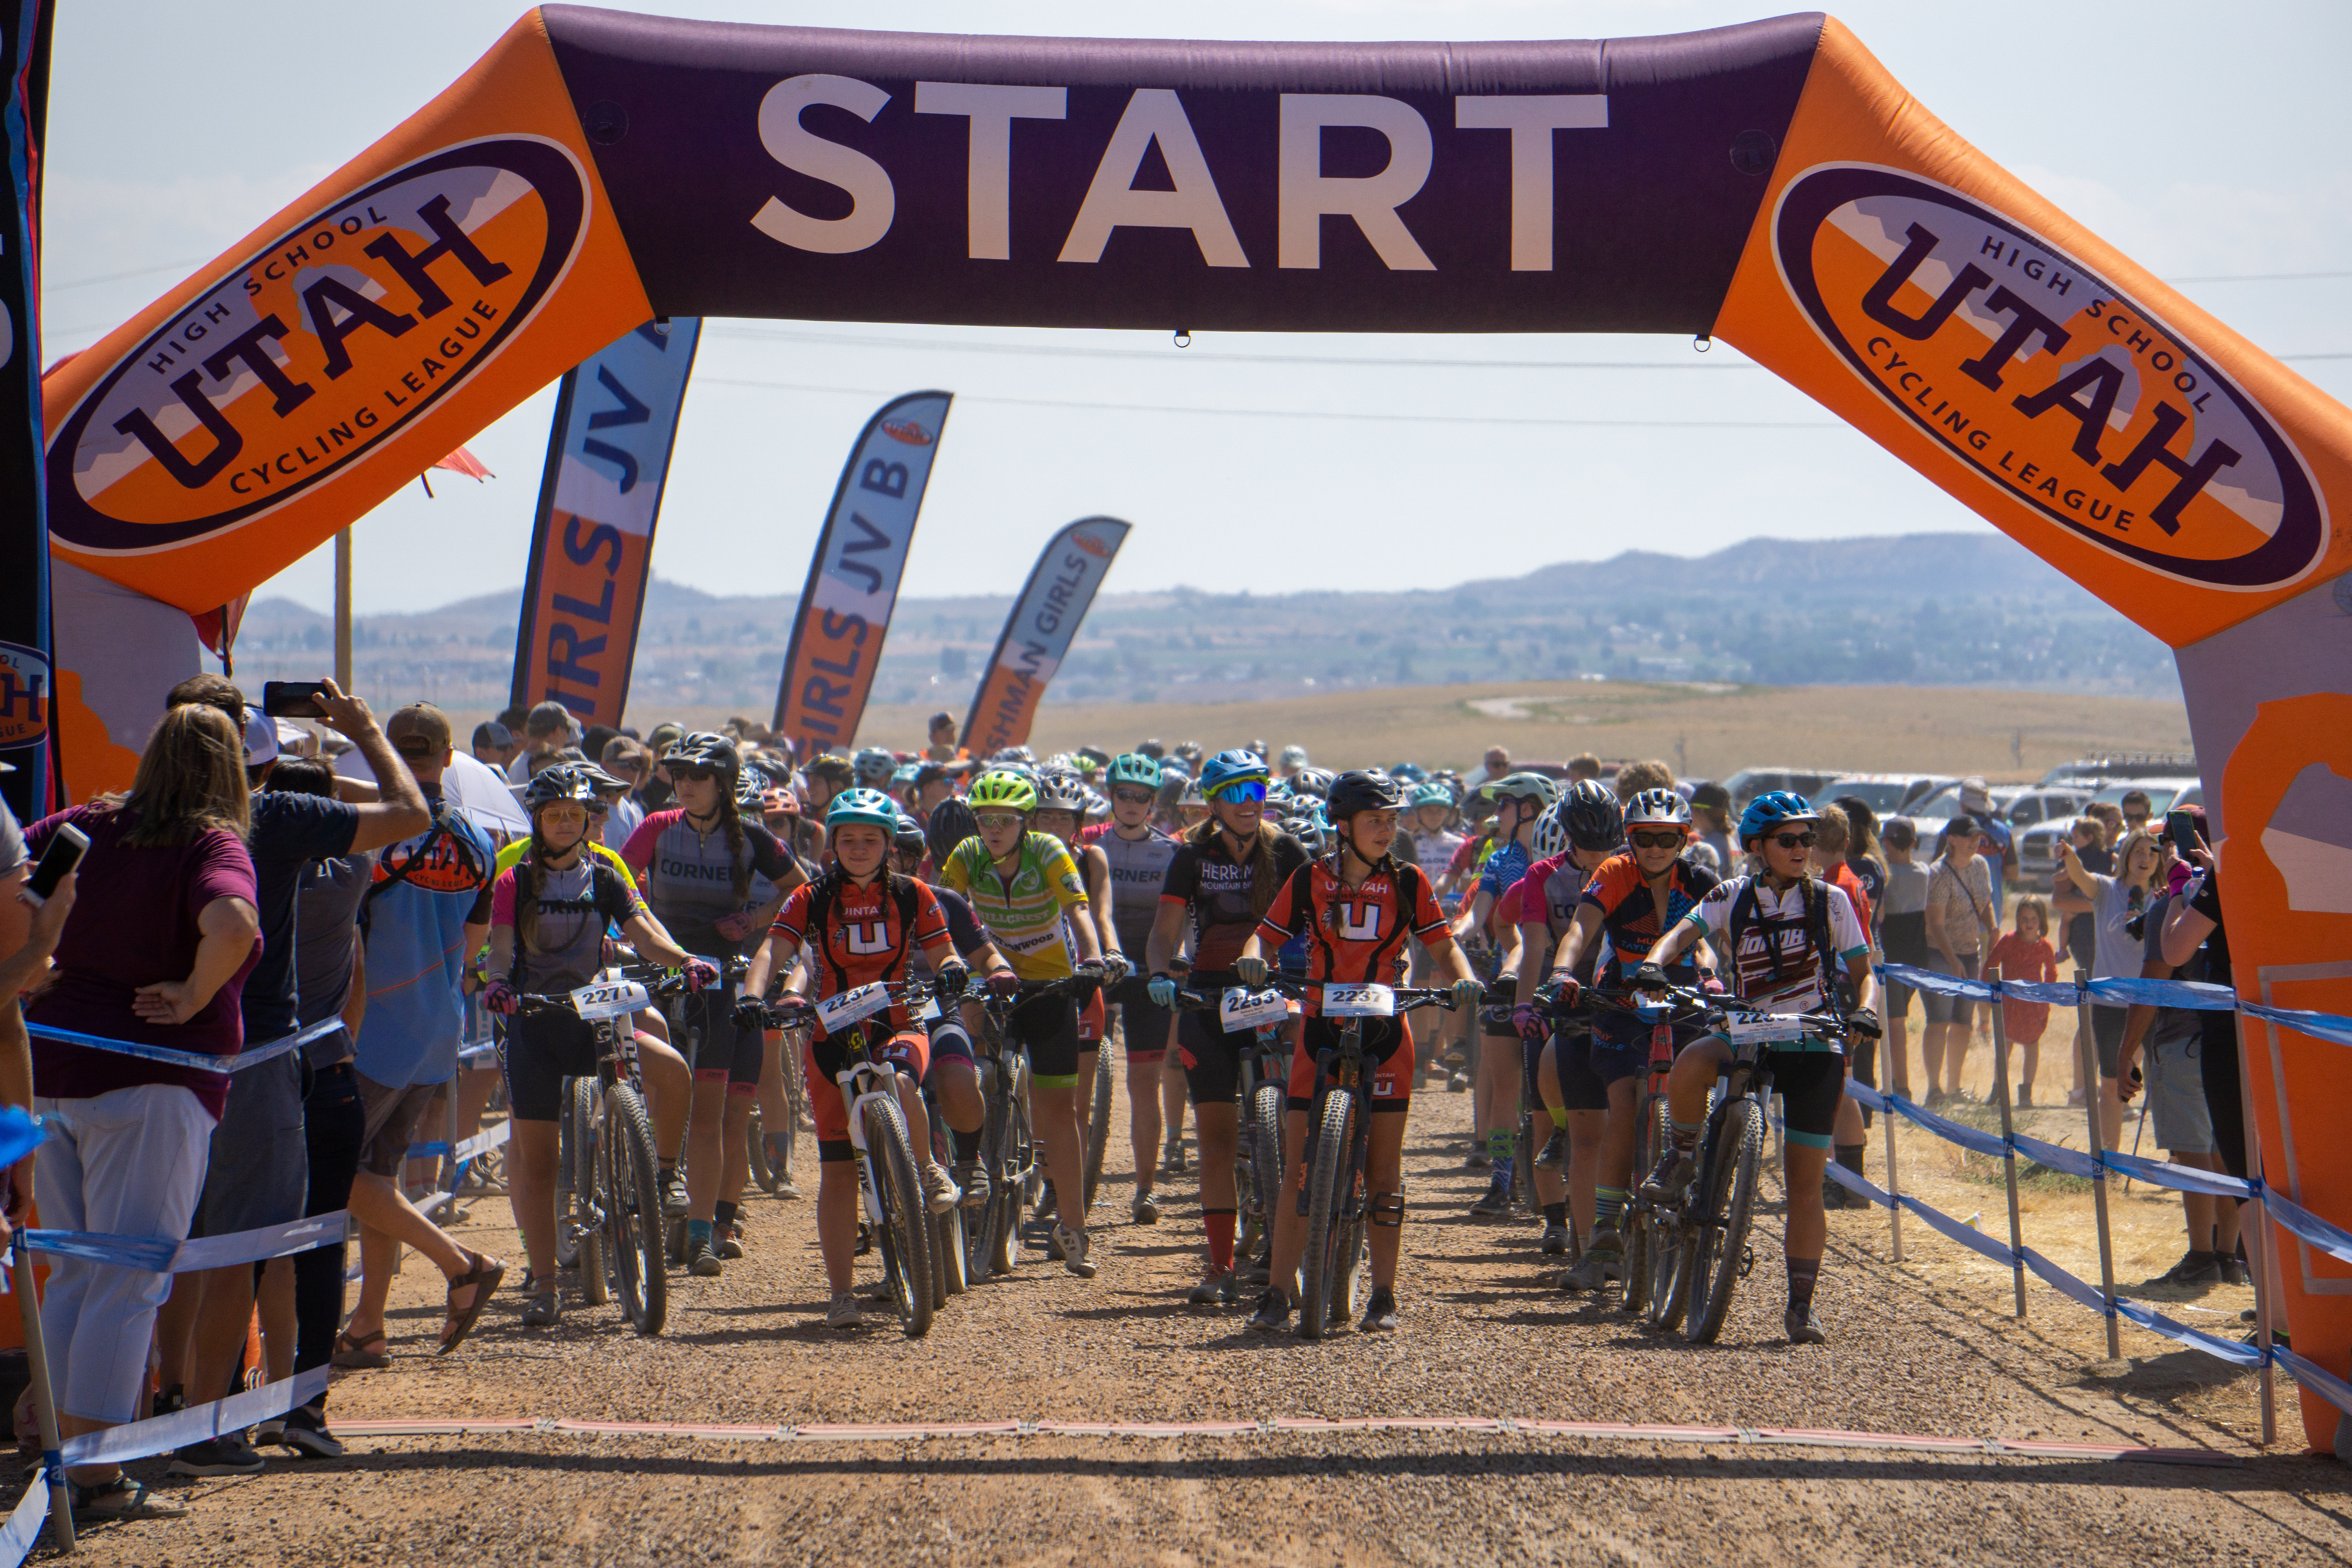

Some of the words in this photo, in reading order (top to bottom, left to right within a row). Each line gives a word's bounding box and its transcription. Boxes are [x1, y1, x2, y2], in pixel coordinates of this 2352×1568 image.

[750, 74, 1608, 270] START
[113, 194, 513, 490] UTAH
[148, 302, 230, 375] HIGH
[243, 205, 388, 297] SCHOOL
[1980, 235, 2073, 296] HIGH
[2085, 299, 2212, 414] SCHOOL
[230, 407, 379, 494] CYCLING
[384, 299, 498, 407] LEAGUE
[583, 365, 651, 494] JV
[1860, 221, 2242, 537] UTAH
[861, 458, 910, 500] B
[1867, 336, 1991, 451] CYCLING
[1998, 450, 2135, 532] LEAGUE
[838, 512, 891, 595] JV
[545, 514, 622, 716] IRLS
[982, 639, 1048, 756] SHMAN
[1036, 554, 1087, 635] GIRLS
[844, 906, 880, 916] INTA
[1112, 868, 1161, 882] RNER
[1200, 881, 1240, 890] MOUNTAIN
[1349, 893, 1384, 903] SCHOOL
[842, 921, 897, 955] U
[583, 985, 634, 1005] 2271
[825, 984, 874, 1013] 2232
[1332, 990, 1381, 1002] 2237
